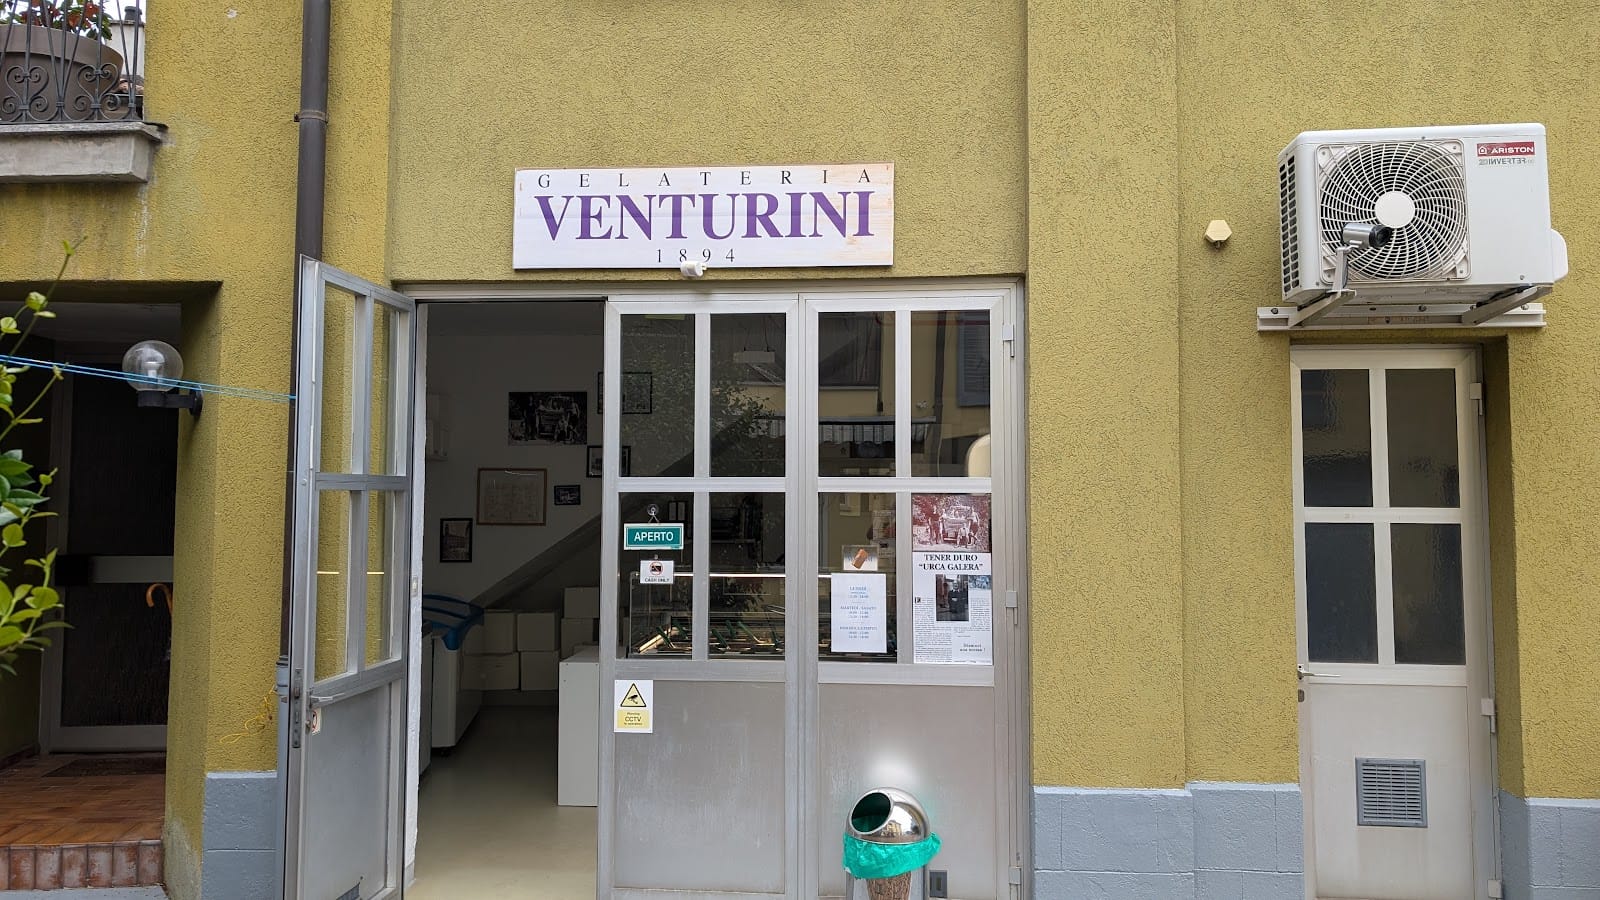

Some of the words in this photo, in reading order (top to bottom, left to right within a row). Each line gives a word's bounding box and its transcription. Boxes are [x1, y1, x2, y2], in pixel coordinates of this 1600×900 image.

[1491, 146, 1534, 154] ARISTON
[537, 168, 871, 188] GELATERIA
[534, 190, 875, 241] VENTURINI
[656, 248, 735, 263] 1894
[633, 531, 674, 542] APERTO
